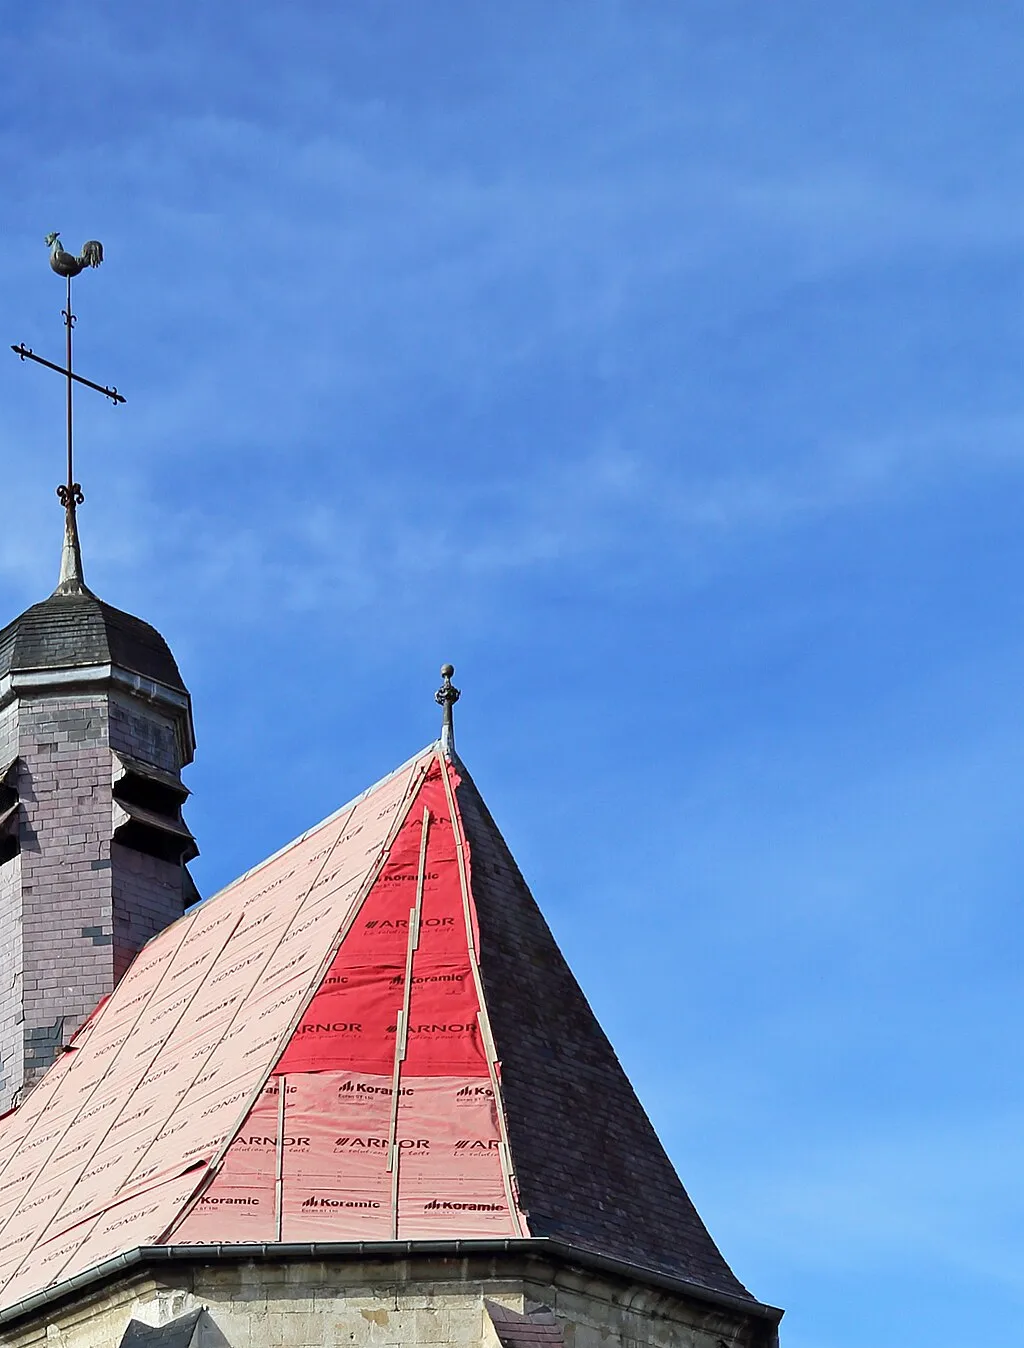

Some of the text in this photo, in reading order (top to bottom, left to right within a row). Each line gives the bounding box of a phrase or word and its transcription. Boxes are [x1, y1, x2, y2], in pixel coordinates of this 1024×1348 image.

[379, 917, 455, 929] AROR
[232, 1136, 311, 1146] ARNOR
[200, 1196, 260, 1205] Koramic
[320, 1198, 381, 1209] Koramic
[442, 1201, 505, 1212] Koramic
